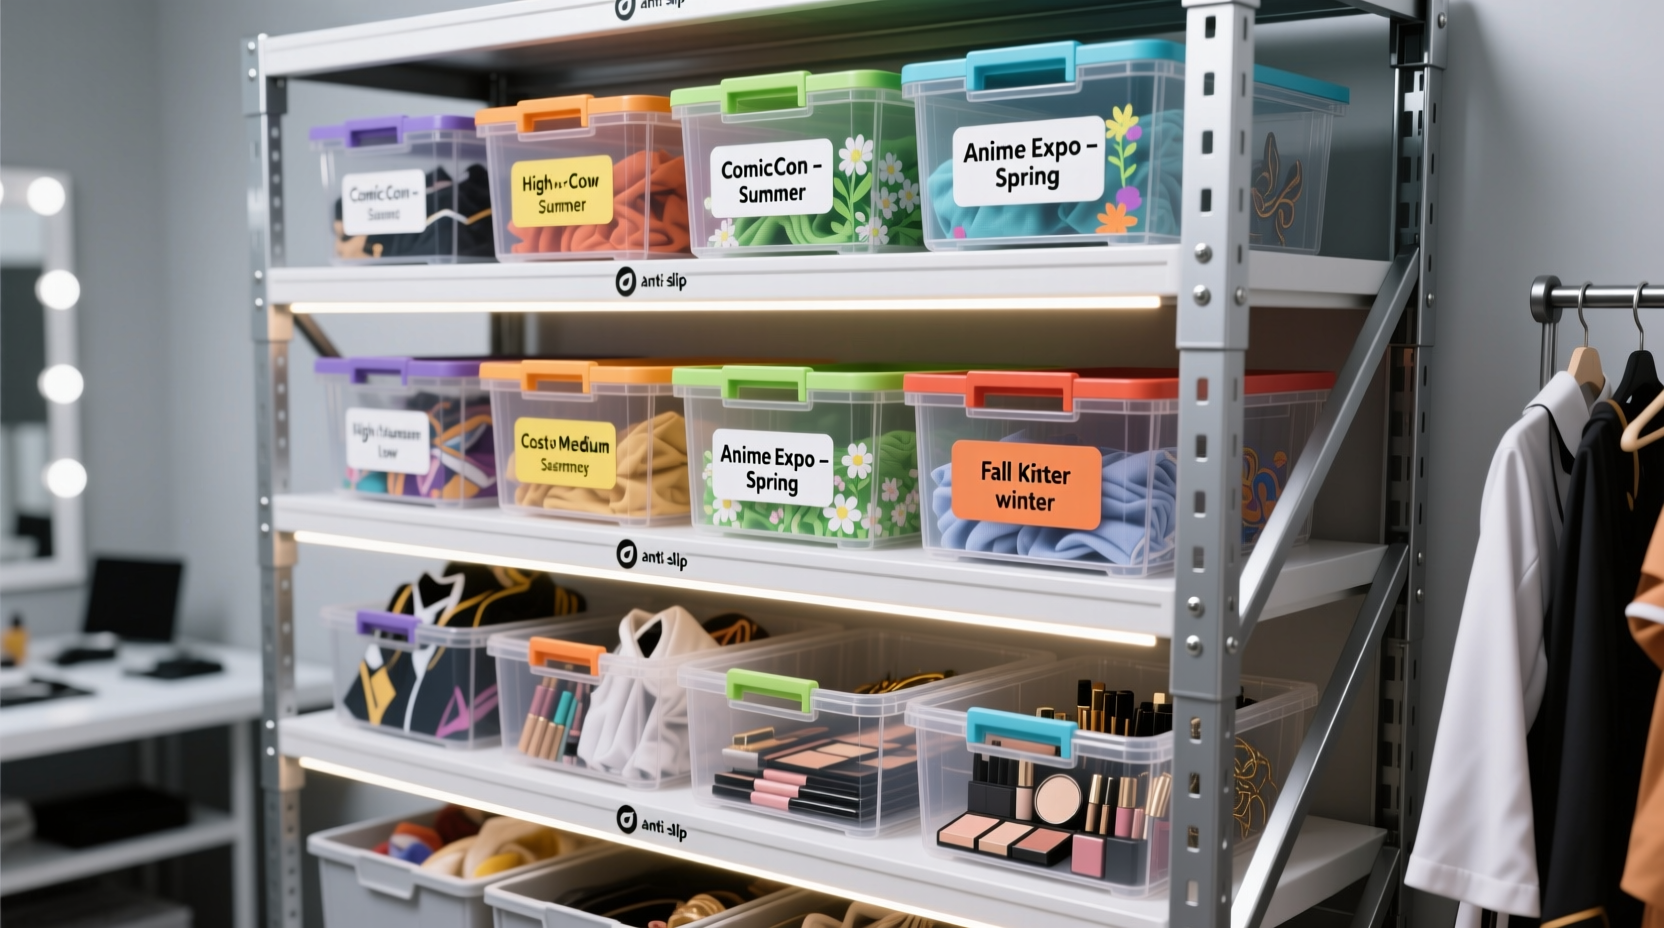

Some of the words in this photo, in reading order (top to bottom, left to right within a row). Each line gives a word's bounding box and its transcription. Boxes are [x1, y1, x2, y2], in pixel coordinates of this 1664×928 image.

[963, 140, 1026, 163] Anime
[1031, 137, 1081, 163] Expo
[995, 165, 1060, 193] Spring
[738, 186, 806, 203] Summer
[720, 444, 772, 465] Anime
[775, 448, 815, 471] Expo
[746, 471, 798, 497] Spring
[981, 460, 1012, 482] Fall
[995, 489, 1056, 512] winter
